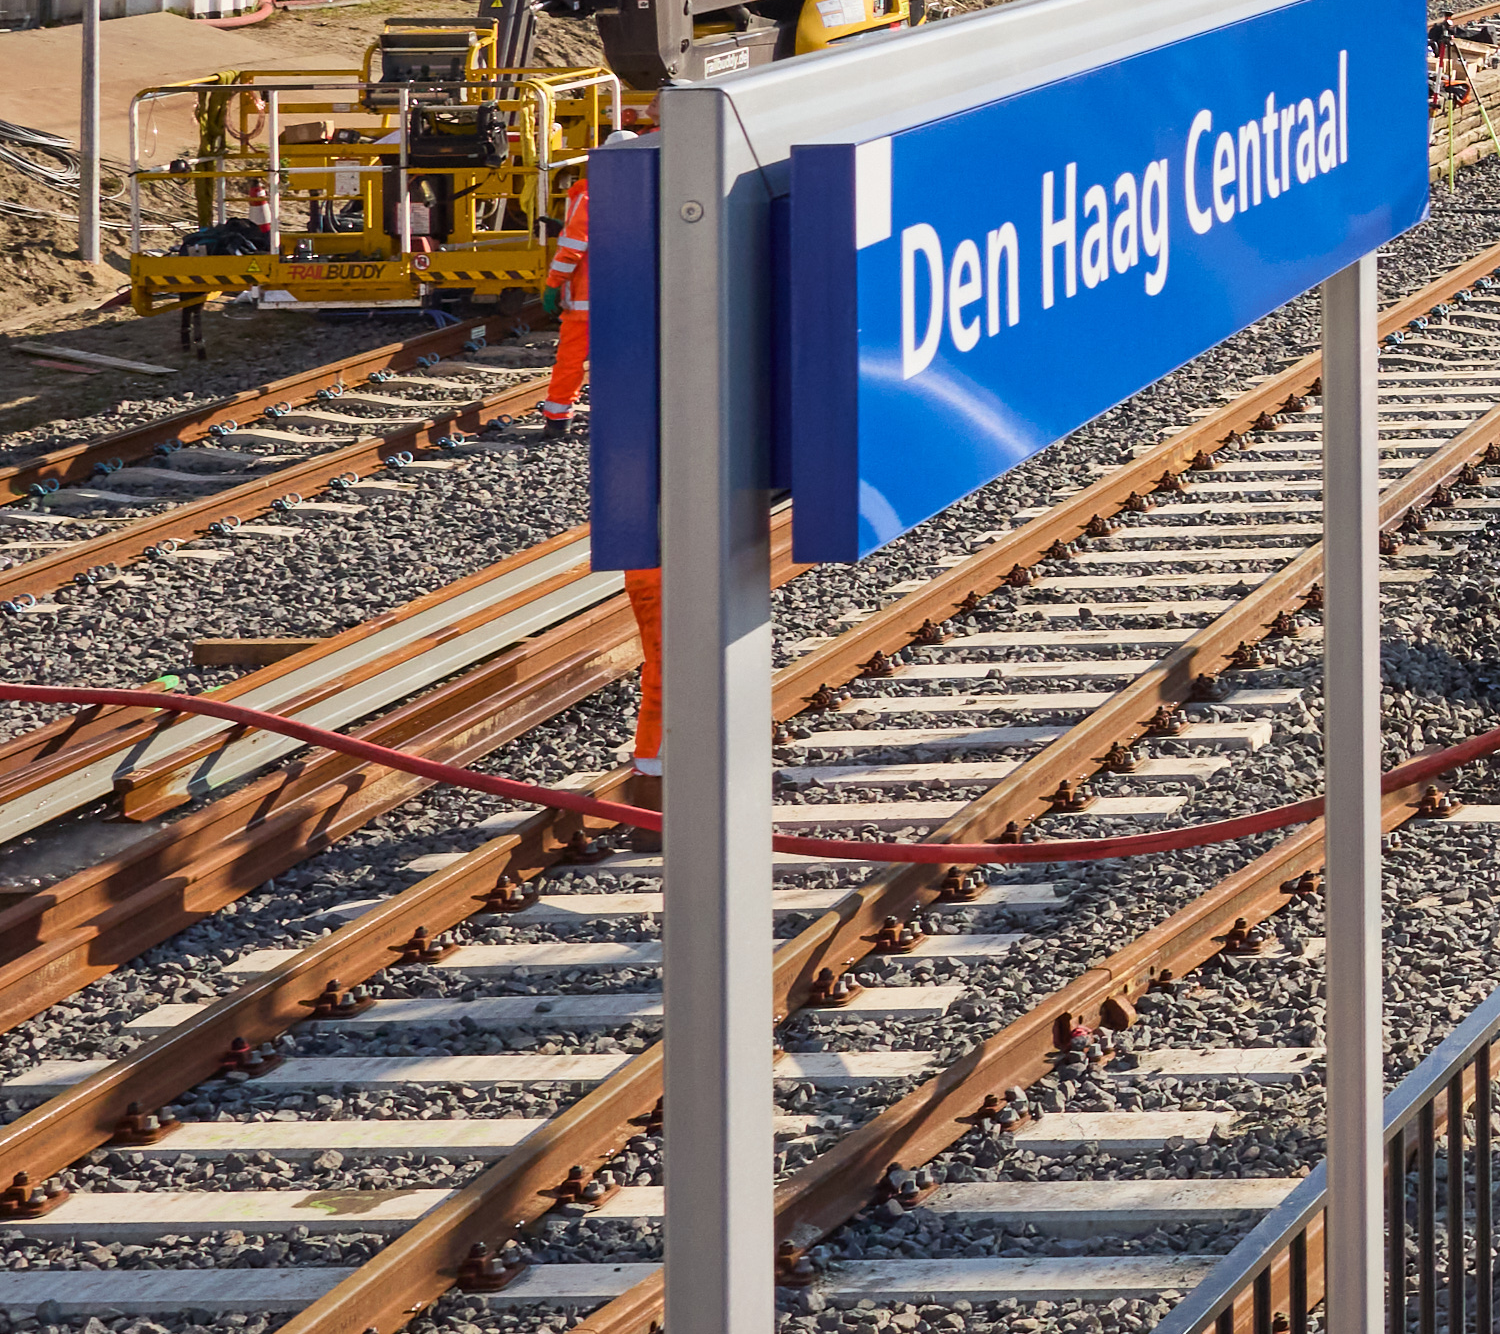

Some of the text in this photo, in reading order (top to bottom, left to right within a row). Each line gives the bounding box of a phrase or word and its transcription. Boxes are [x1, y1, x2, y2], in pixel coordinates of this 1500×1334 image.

[288, 264, 386, 280] RAILBUDDY
[901, 50, 1350, 381] Den Haag Centraal
